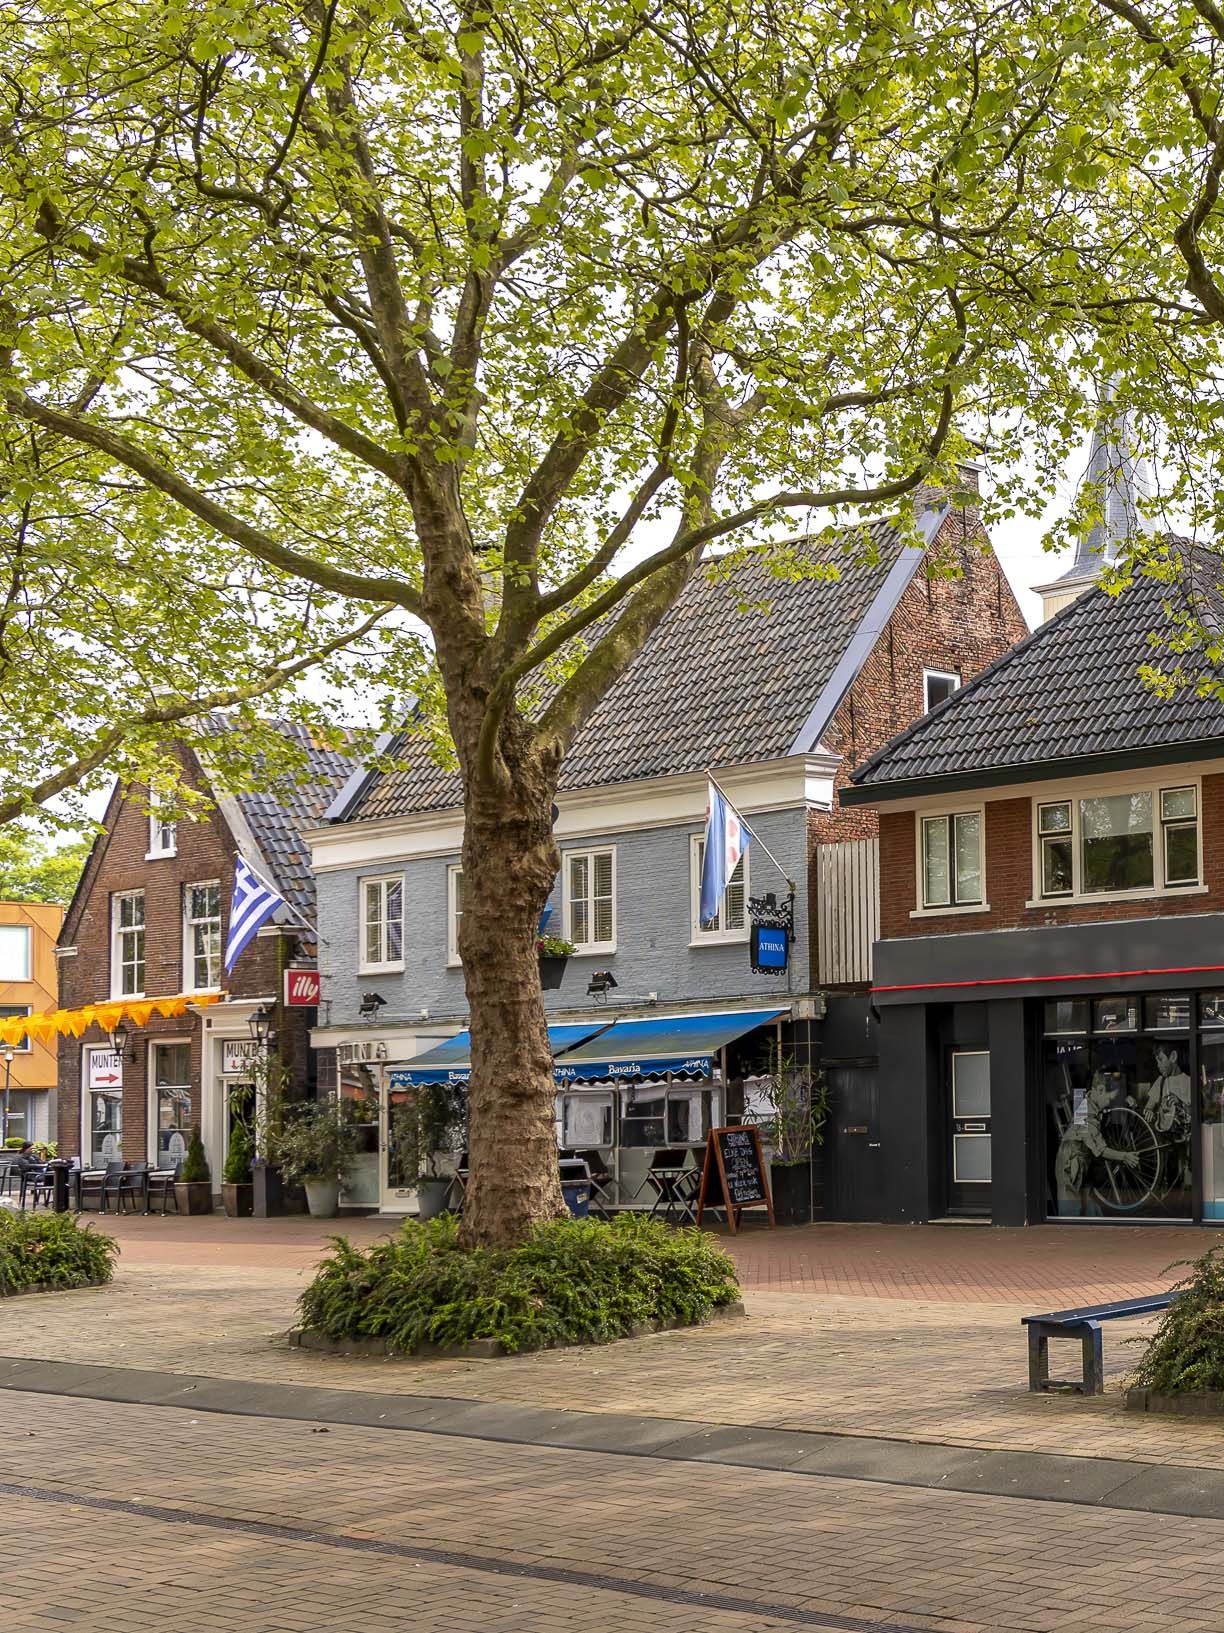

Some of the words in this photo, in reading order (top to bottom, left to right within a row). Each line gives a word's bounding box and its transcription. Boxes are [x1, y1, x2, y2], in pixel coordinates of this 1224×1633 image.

[759, 942, 785, 952] ATHINA
[292, 975, 319, 1002] illy
[226, 1042, 258, 1058] MUNTE
[608, 1062, 641, 1074] Bavaria
